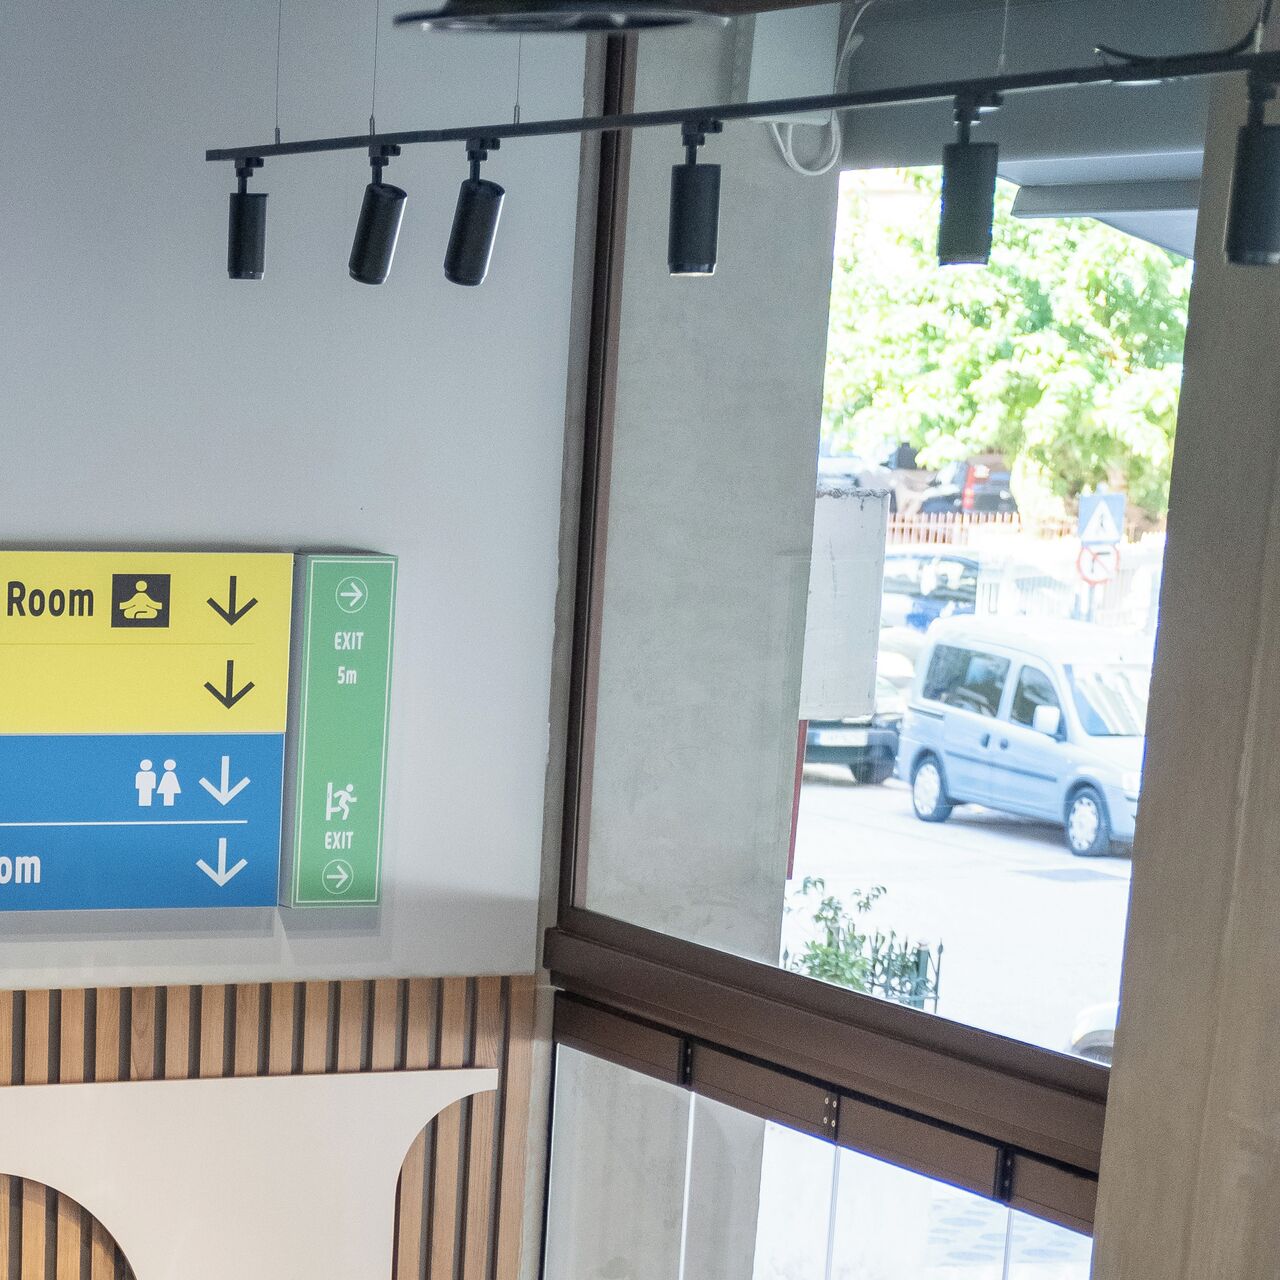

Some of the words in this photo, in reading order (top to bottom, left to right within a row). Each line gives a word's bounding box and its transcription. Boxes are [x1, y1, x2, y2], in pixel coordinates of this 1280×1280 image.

[8, 580, 95, 617] Room
[334, 632, 364, 650] EXIT
[337, 666, 358, 685] 5m
[325, 831, 354, 850] EXIT
